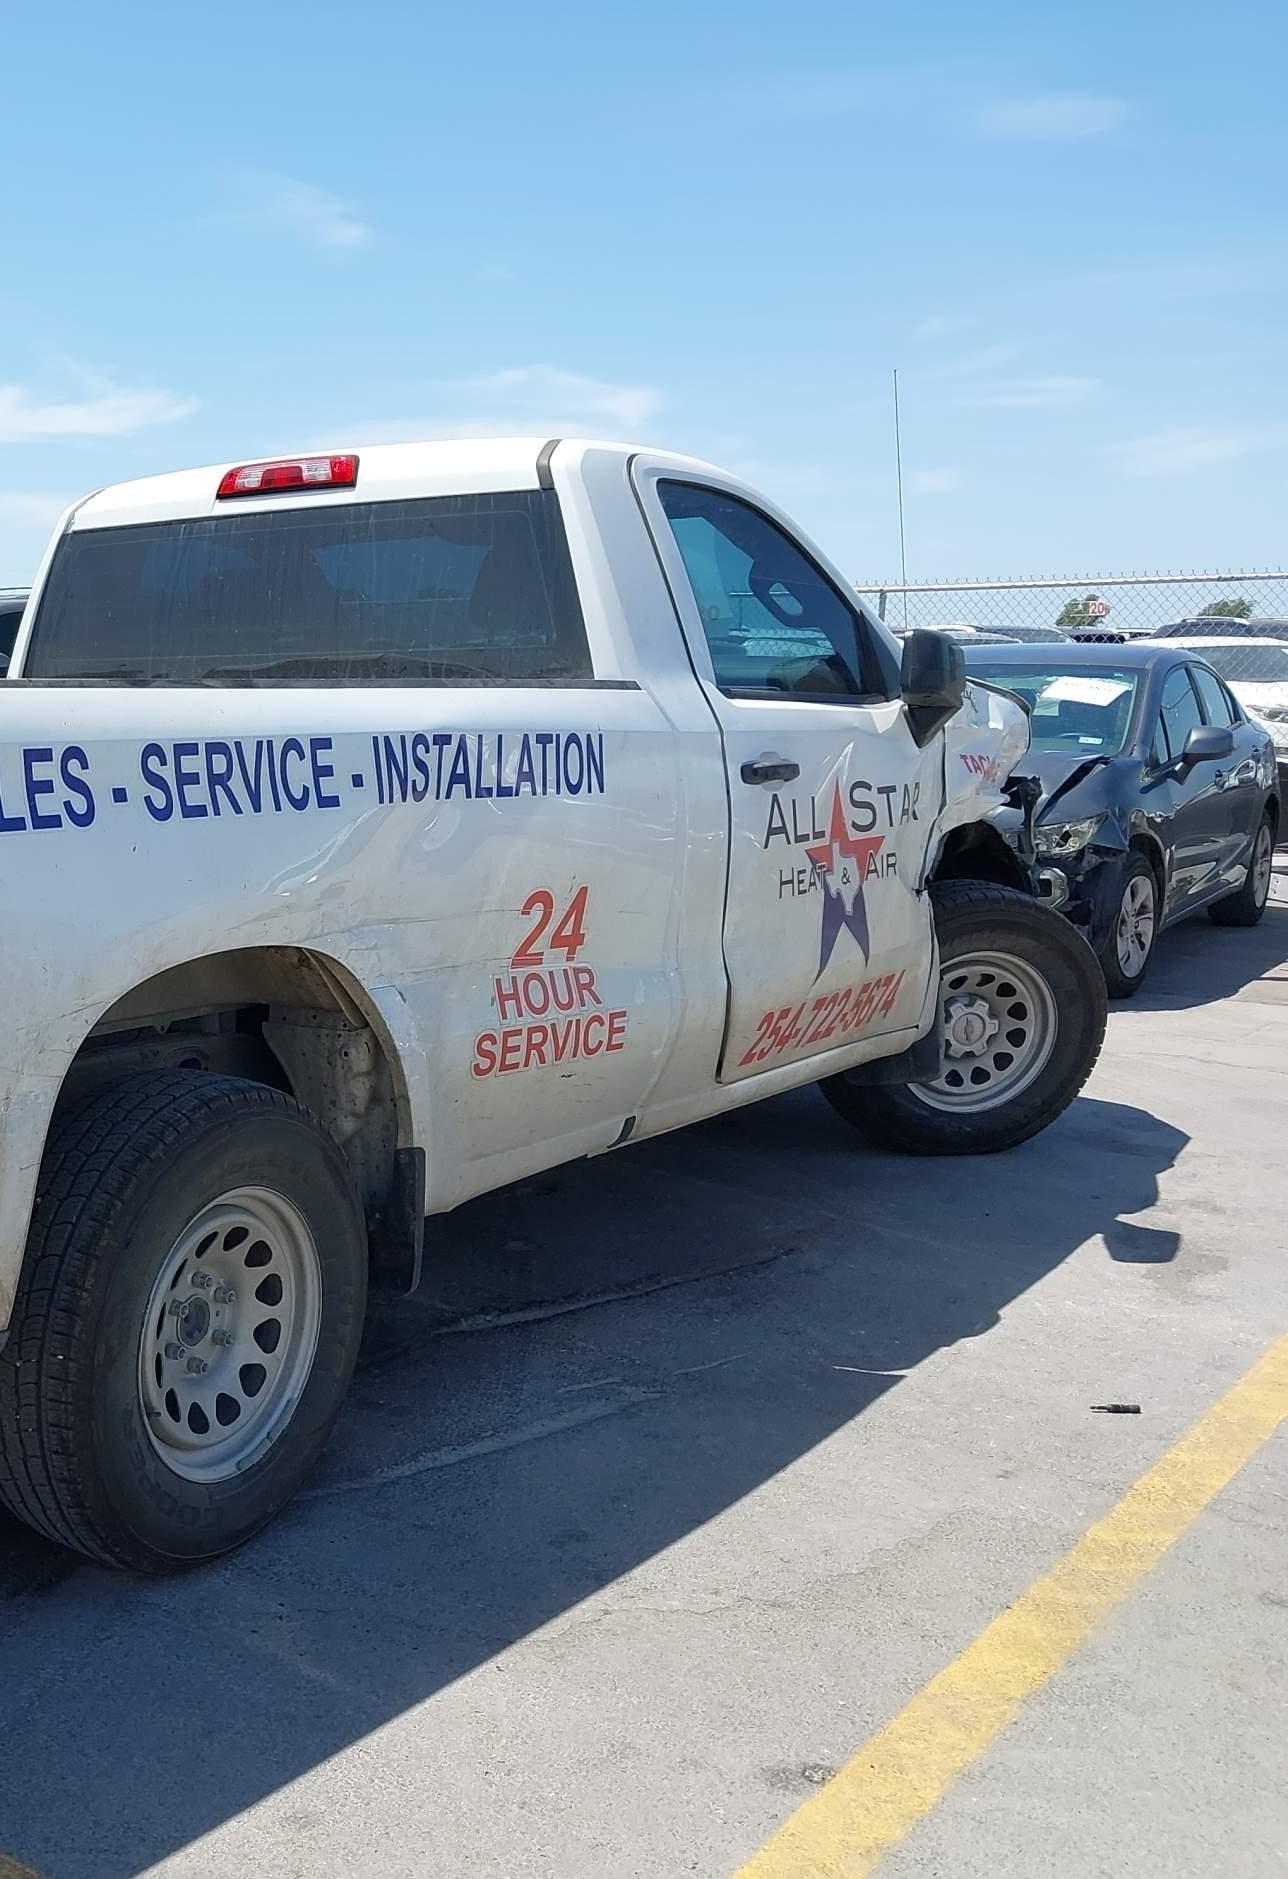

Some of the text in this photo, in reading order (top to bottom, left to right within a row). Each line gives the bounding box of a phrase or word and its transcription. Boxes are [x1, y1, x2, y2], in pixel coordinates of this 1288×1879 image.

[140, 737, 341, 822] SERVICE
[372, 732, 606, 805] INSTALLATION
[763, 780, 921, 850] ALL STAR
[779, 852, 898, 899] HEAT & AIR
[510, 886, 589, 969] 24
[495, 967, 603, 1021] HOUR
[738, 968, 906, 1067] 254-722-5674
[472, 1010, 628, 1077] SERVICE
